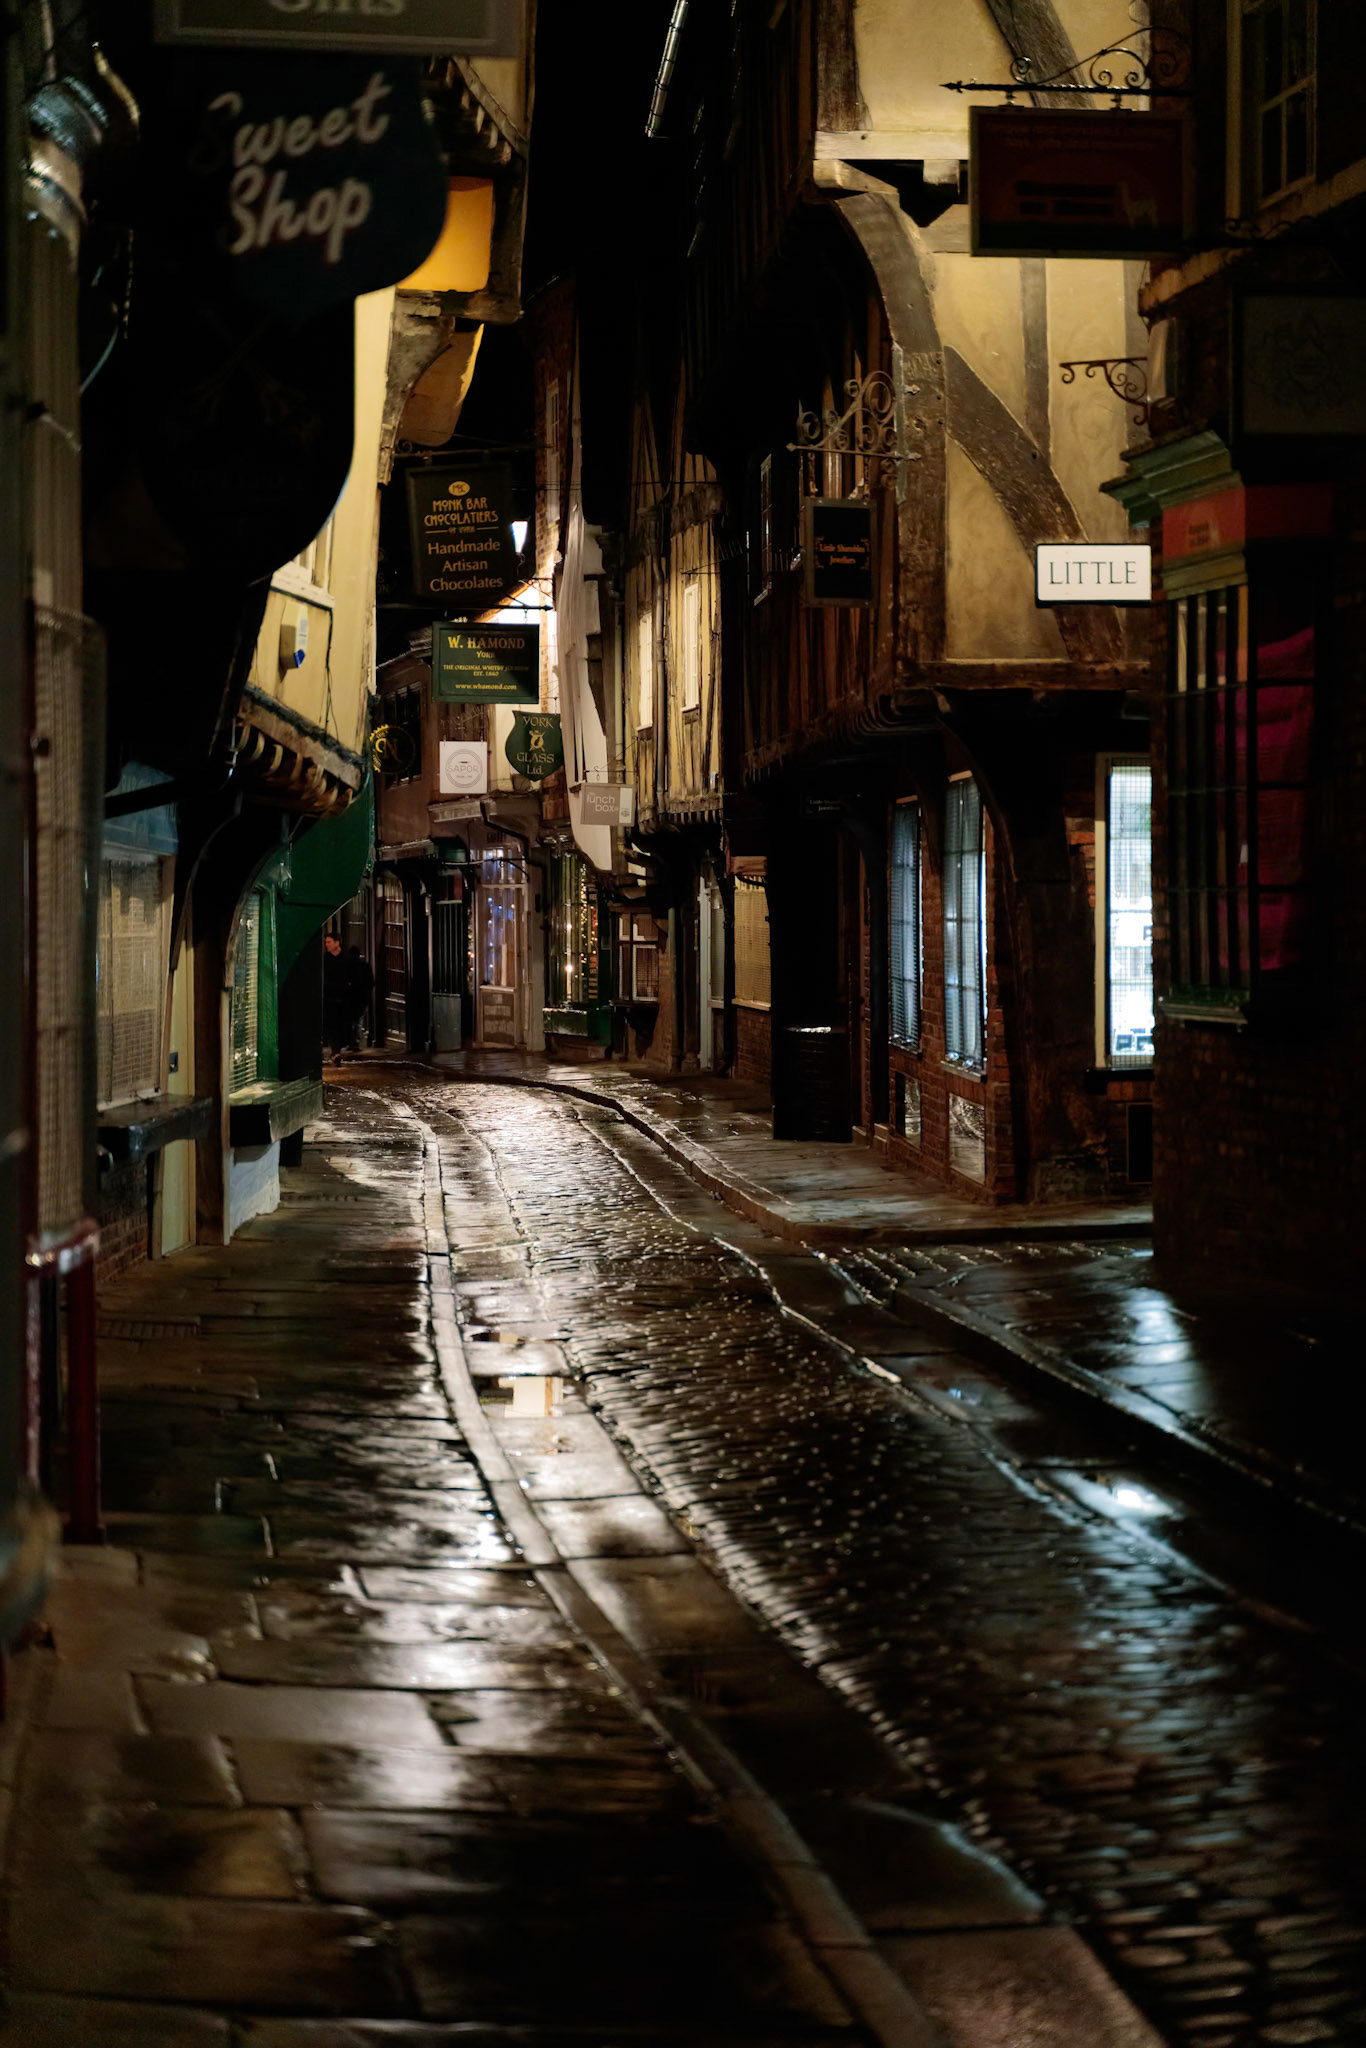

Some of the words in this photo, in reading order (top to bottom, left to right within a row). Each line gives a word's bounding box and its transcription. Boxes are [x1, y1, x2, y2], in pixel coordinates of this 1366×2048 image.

[188, 71, 393, 174] Sweet
[225, 163, 373, 264] Shop
[433, 499, 463, 513] MONK
[466, 497, 488, 510] BAR
[424, 510, 499, 527] CHOCOLATIERS
[427, 538, 501, 555] Handmade
[441, 559, 488, 573] Artisan
[1049, 561, 1137, 585] LITTLE
[429, 576, 504, 592] Chocolates
[447, 635, 464, 649] W.
[467, 637, 525, 649] HAMOND
[476, 651, 496, 659] YORK
[523, 716, 553, 729] YORK
[517, 752, 555, 763] GLASS
[447, 764, 480, 774] SAPOR
[527, 764, 544, 775] Ltd.
[586, 793, 615, 804] lunch
[595, 799, 614, 812] box
